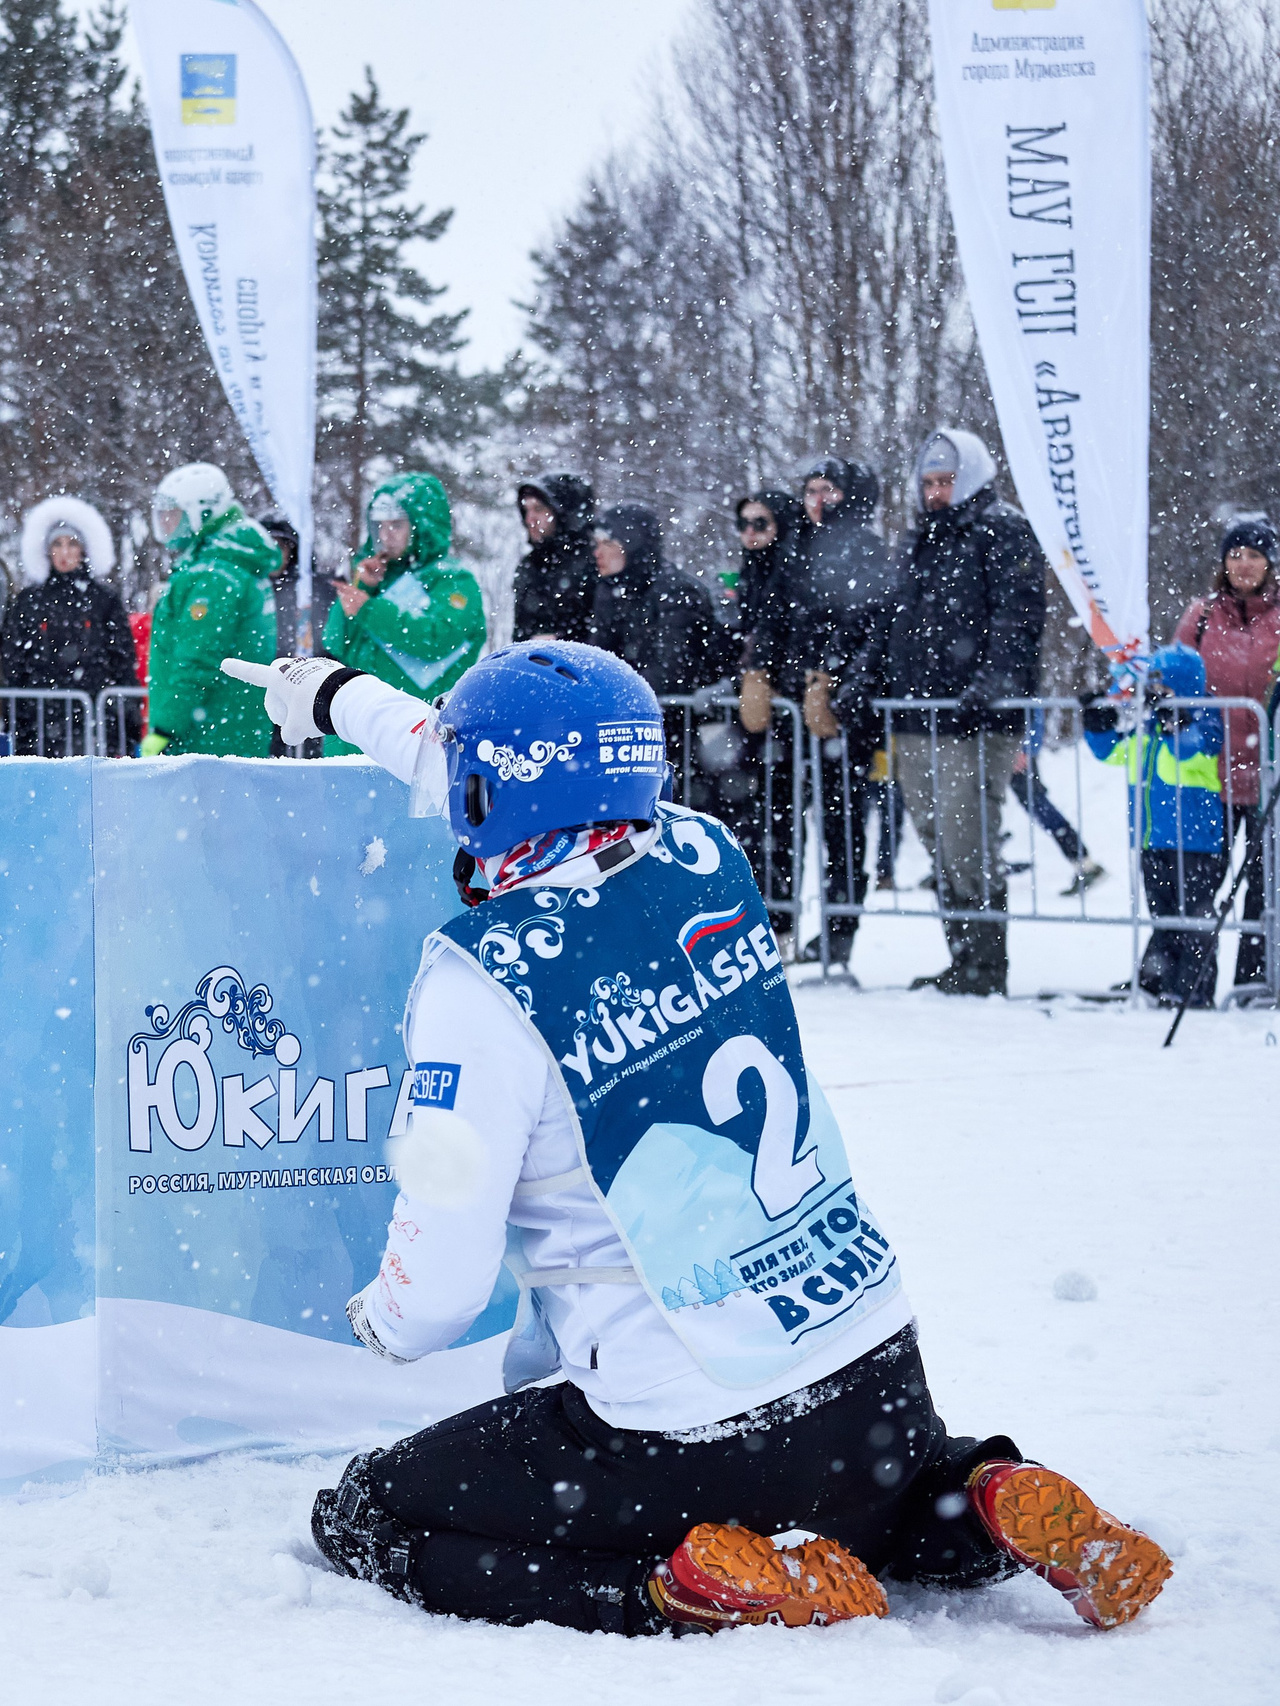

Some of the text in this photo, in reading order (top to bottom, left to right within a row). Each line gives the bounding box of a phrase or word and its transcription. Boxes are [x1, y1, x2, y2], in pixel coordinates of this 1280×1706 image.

[1006, 122, 1073, 229] МАУ
[599, 727, 633, 737] ДЛЯ ТЕХ,
[600, 746, 614, 763] В
[621, 1046, 669, 1078] MURMANSK
[669, 1026, 703, 1052] REGION
[702, 1035, 825, 1221] 2
[129, 1172, 215, 1194] РОССИЯ,
[218, 1165, 358, 1191] МУРМАНСКАЯ
[739, 1236, 809, 1283] ДЛЯ ТЕХ,
[749, 1276, 778, 1294] КТО
[764, 1295, 809, 1332] В
